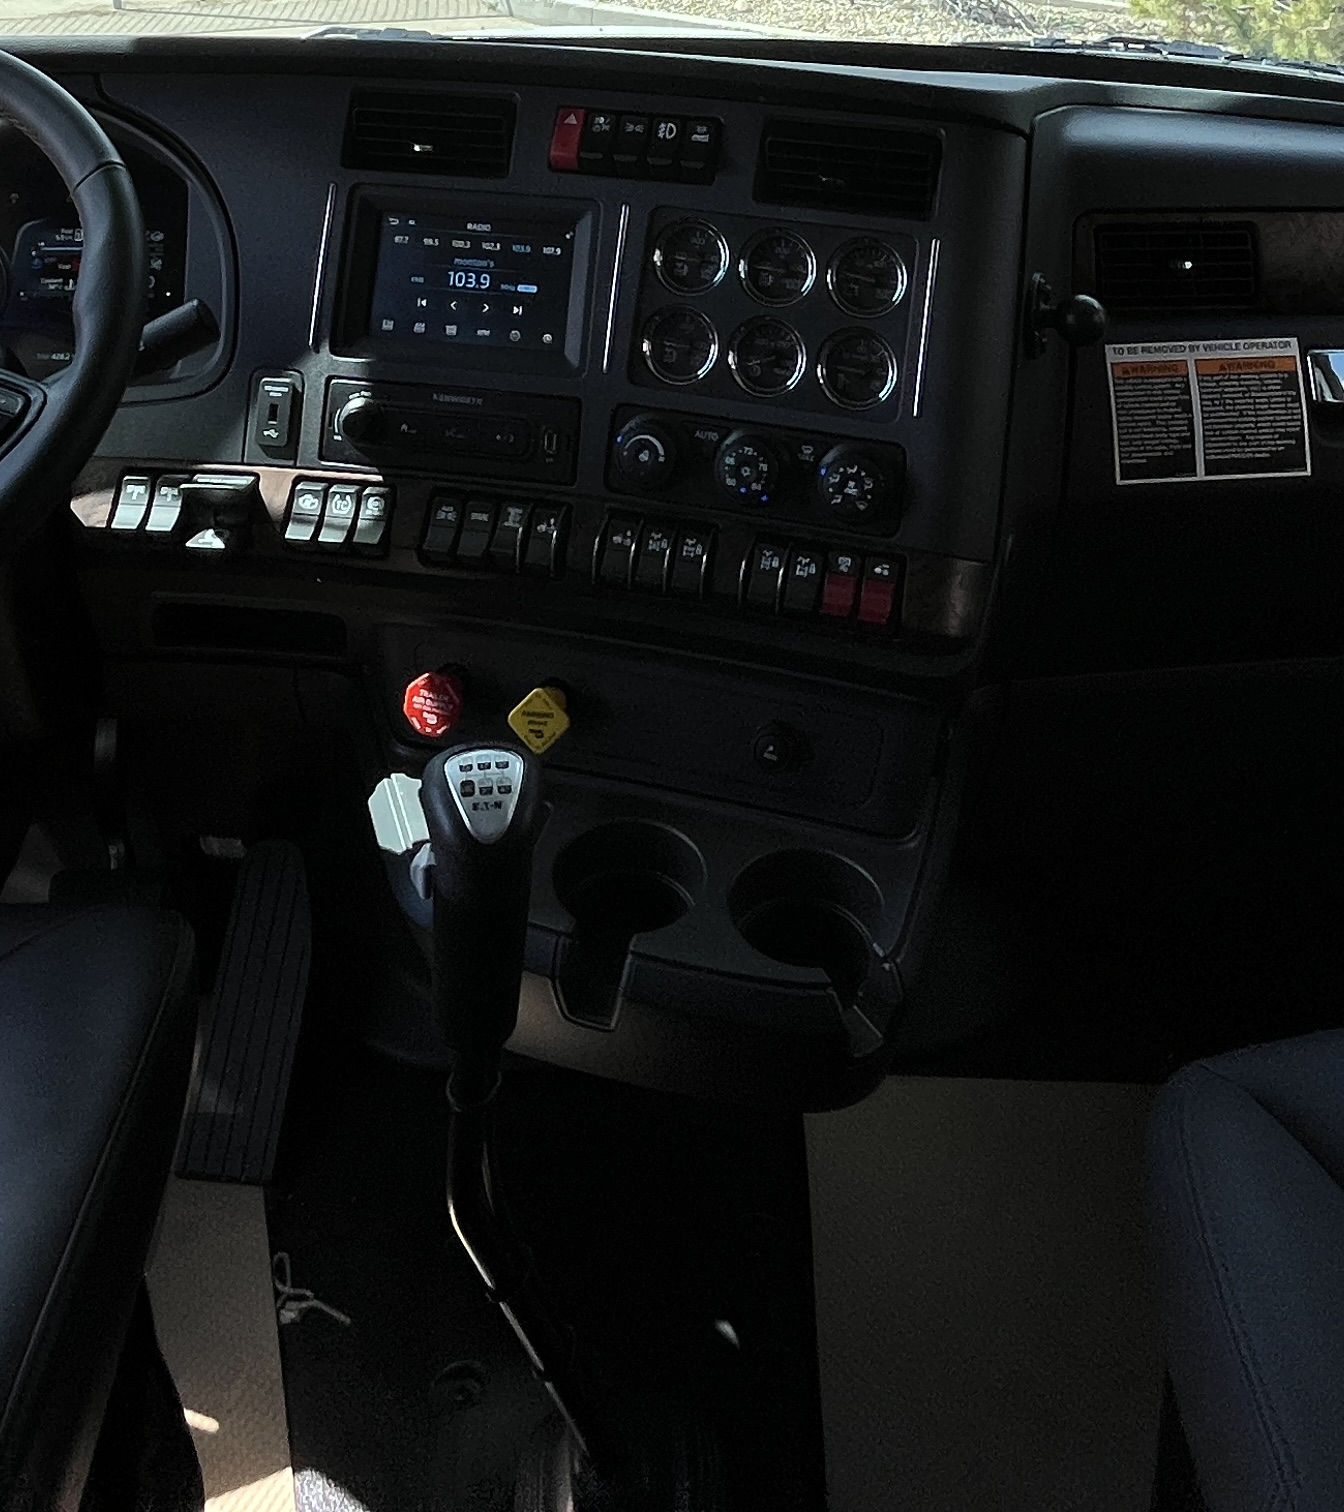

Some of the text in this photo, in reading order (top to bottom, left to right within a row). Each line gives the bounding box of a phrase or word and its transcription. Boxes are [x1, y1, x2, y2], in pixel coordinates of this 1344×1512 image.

[447, 271, 491, 289] 103.9
[1113, 341, 1292, 355] TO BE REMOVED BY VEHICLE OPERATOR
[1129, 364, 1179, 374] WARNING
[1226, 361, 1275, 370] WARNING
